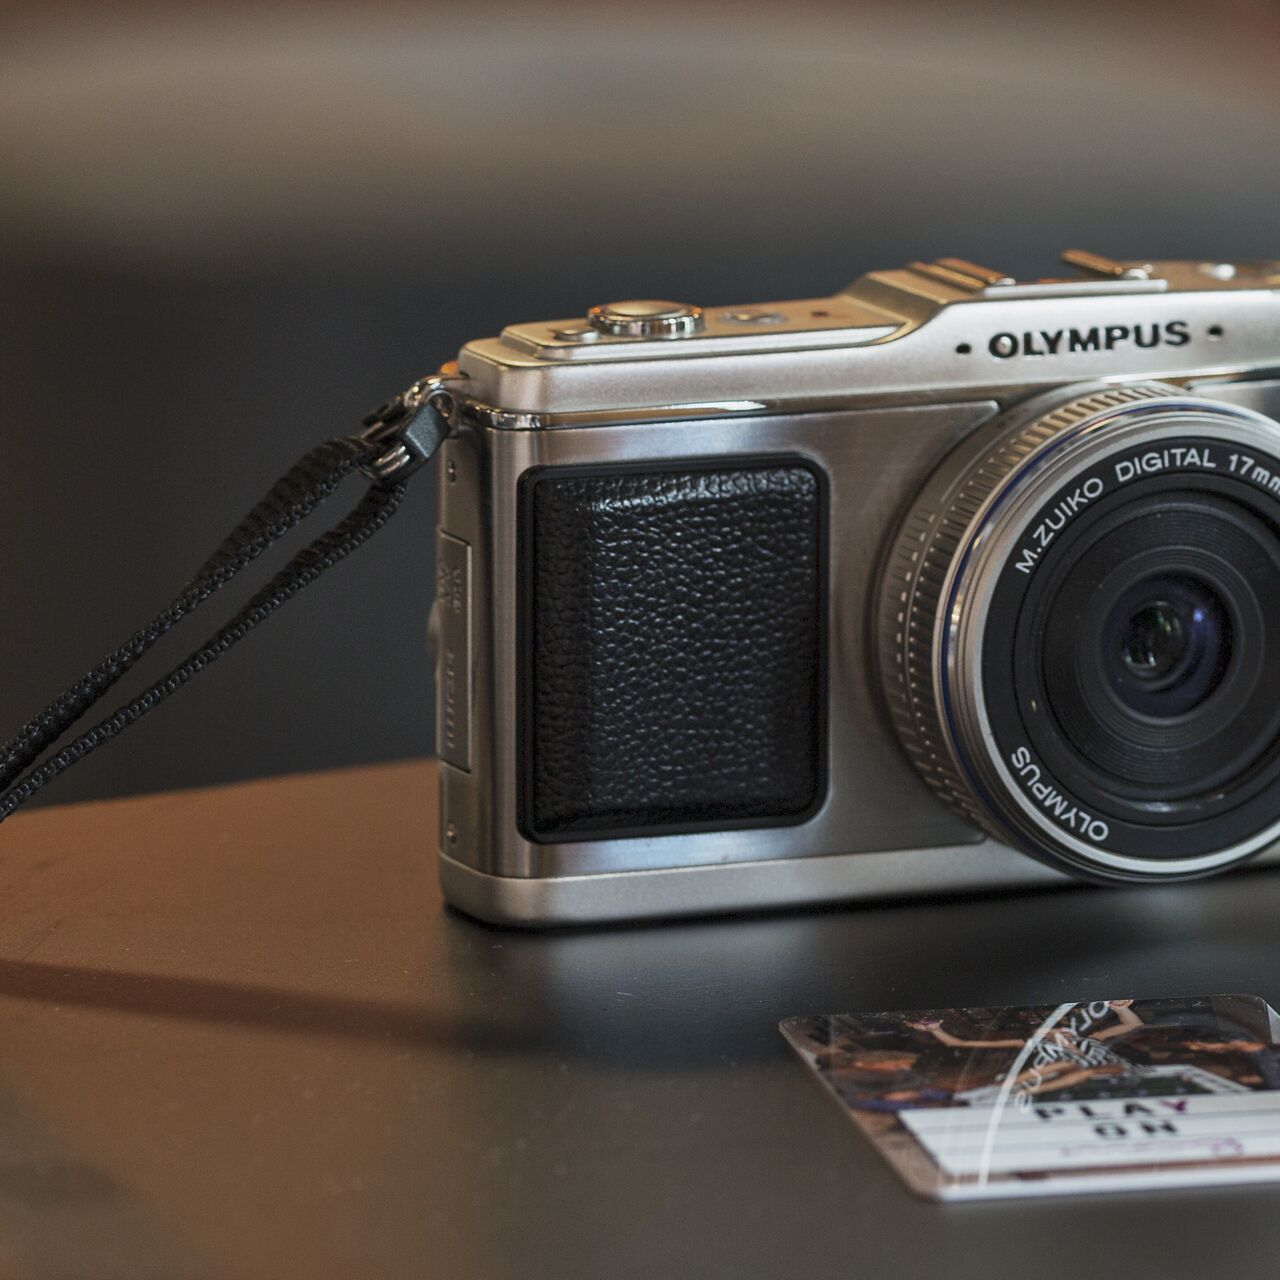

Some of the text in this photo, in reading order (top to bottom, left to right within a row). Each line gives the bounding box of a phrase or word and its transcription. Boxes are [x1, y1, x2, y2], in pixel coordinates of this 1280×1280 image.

[988, 320, 1192, 359] OLYMPUS
[1014, 477, 1104, 574] M.ZUIKO
[1114, 447, 1217, 483] DIGITAL
[1010, 745, 1110, 842] OLYMPUS
[1034, 1099, 1188, 1120] PLAY
